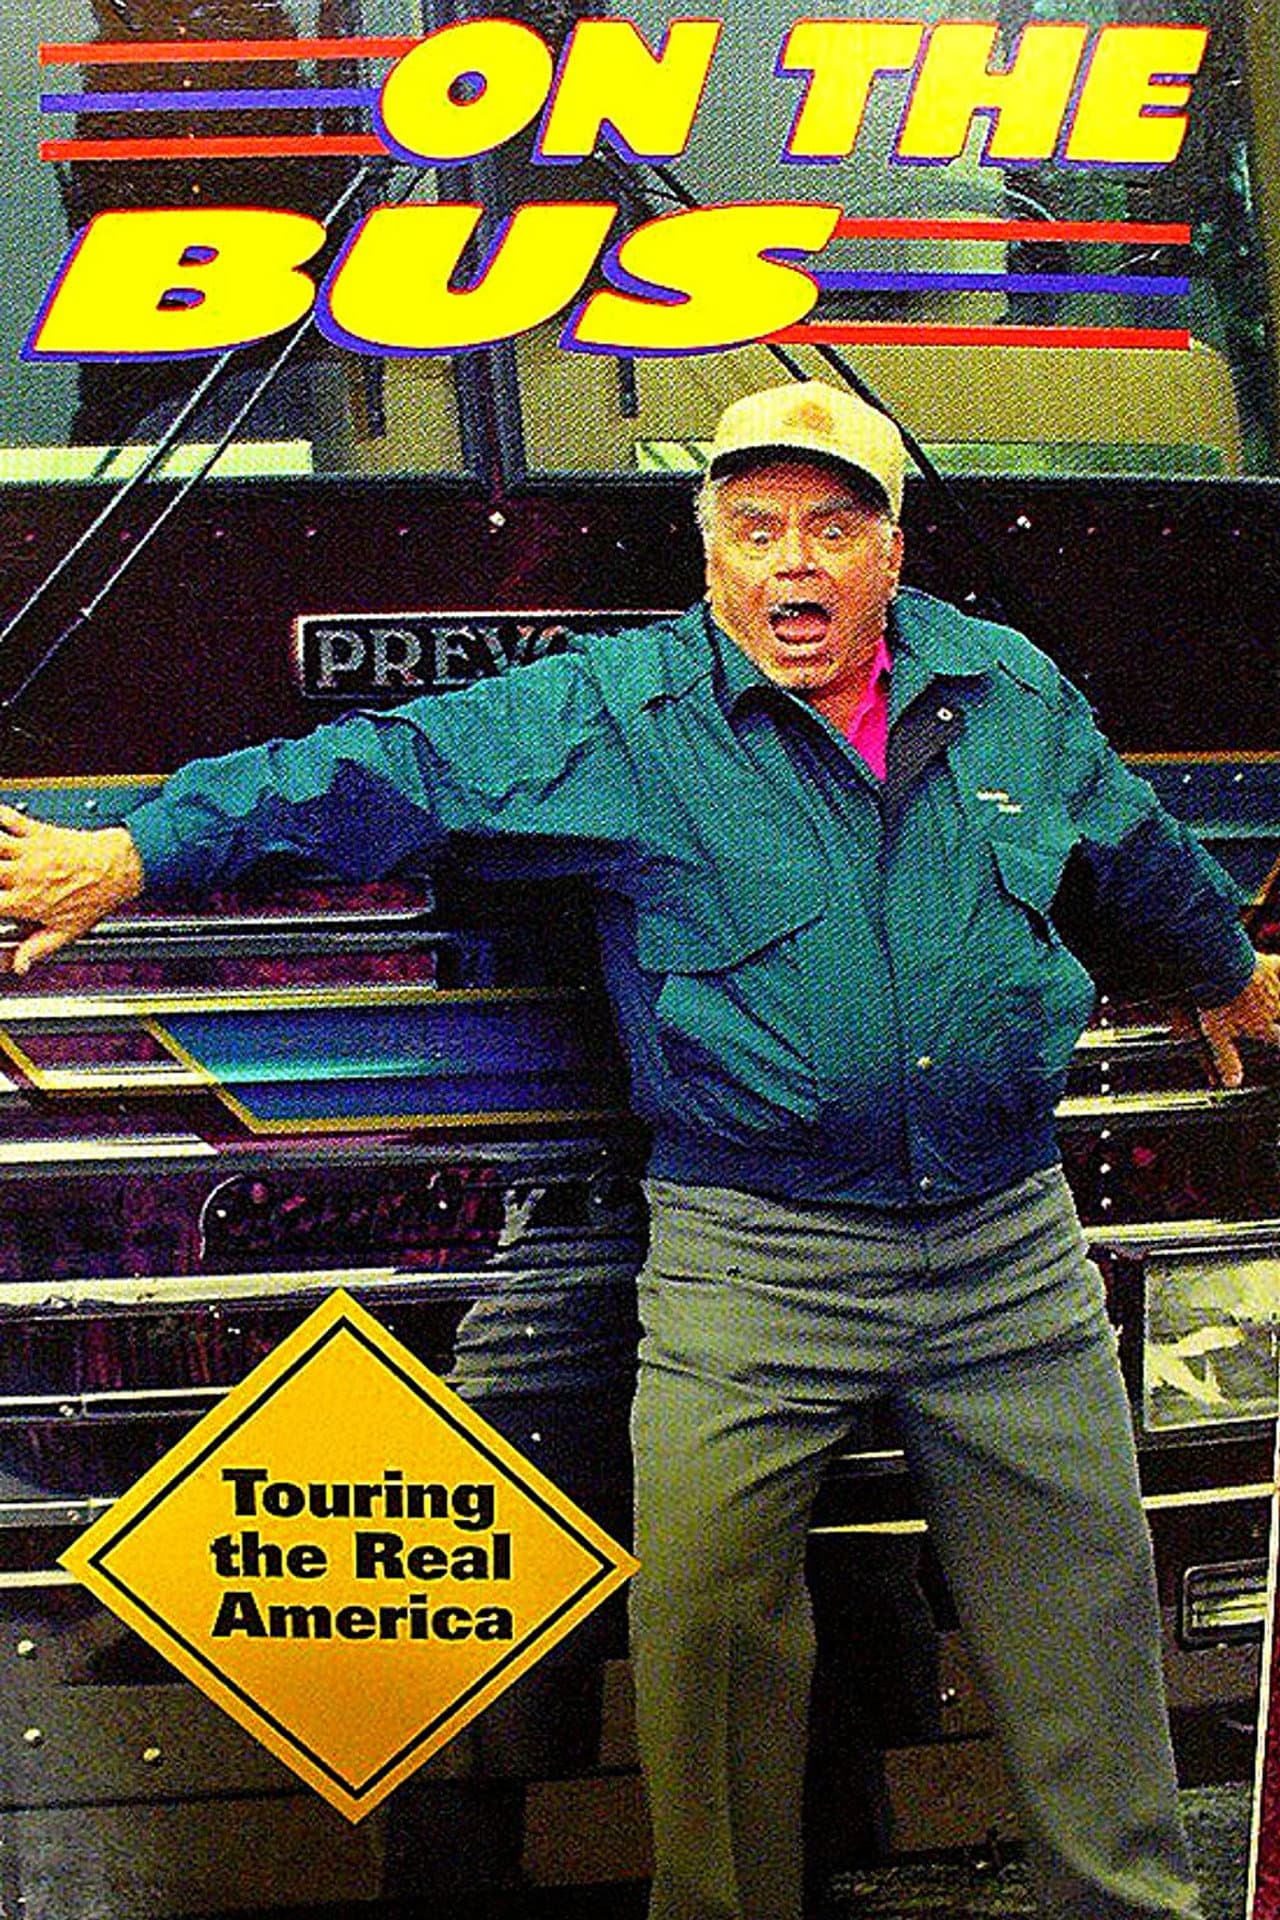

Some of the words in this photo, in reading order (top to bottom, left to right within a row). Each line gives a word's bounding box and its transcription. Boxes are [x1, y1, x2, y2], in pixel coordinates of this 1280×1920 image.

[377, 18, 722, 168] ON
[778, 22, 1208, 167] THE
[20, 203, 842, 361] BUS
[221, 1468, 495, 1531] Touring
[210, 1531, 328, 1578] the
[354, 1531, 512, 1580] Real
[211, 1591, 514, 1641] America
